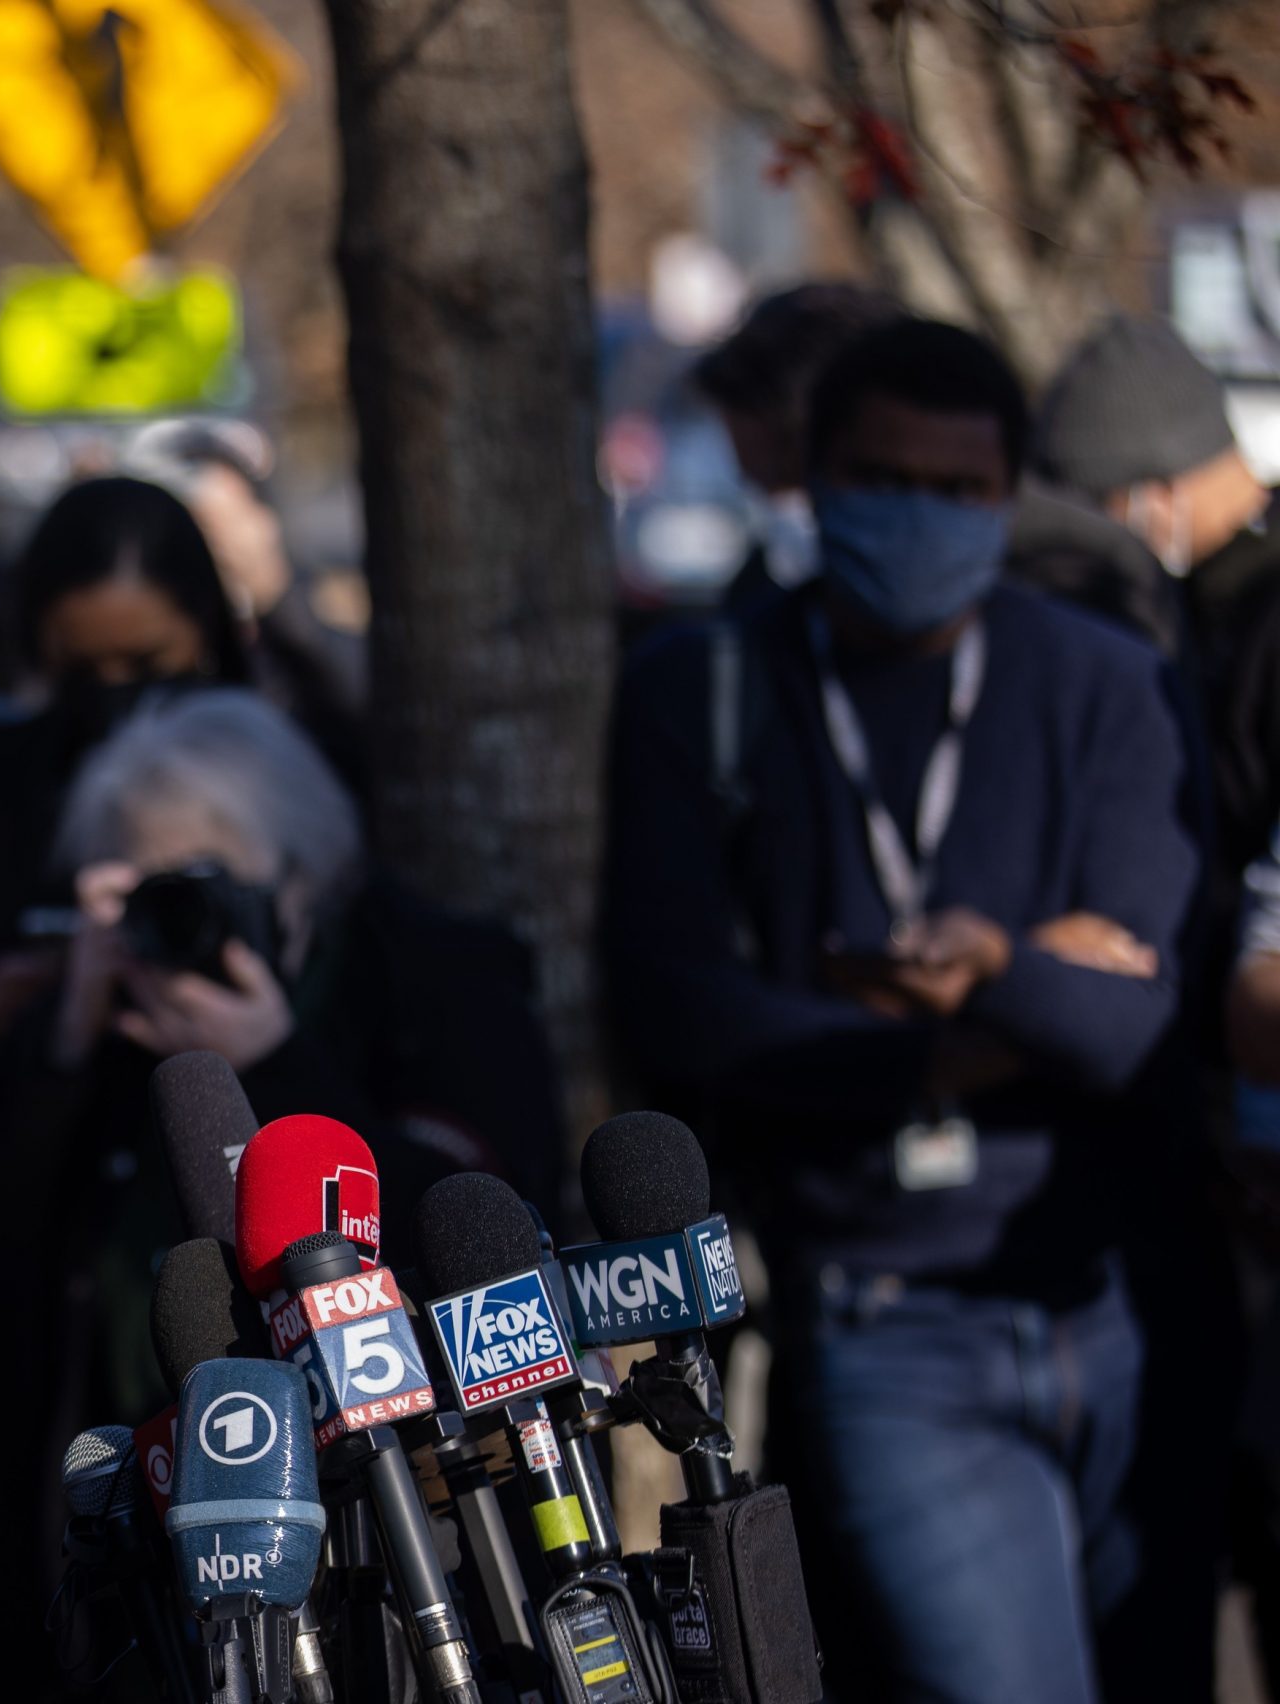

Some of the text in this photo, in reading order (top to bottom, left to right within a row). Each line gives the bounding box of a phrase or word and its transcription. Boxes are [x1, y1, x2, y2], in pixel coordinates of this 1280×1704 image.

[342, 1210, 380, 1245] inte
[312, 1273, 394, 1323] FOX
[568, 1248, 685, 1316] WGN
[273, 1300, 309, 1350] FOX
[475, 1297, 549, 1345] FOX
[587, 1302, 690, 1331] AMERICA
[343, 1317, 405, 1395] 5
[467, 1328, 558, 1380] NEWS
[468, 1361, 565, 1402] channel
[348, 1391, 433, 1425] NEWS
[197, 1553, 264, 1583] NDR
